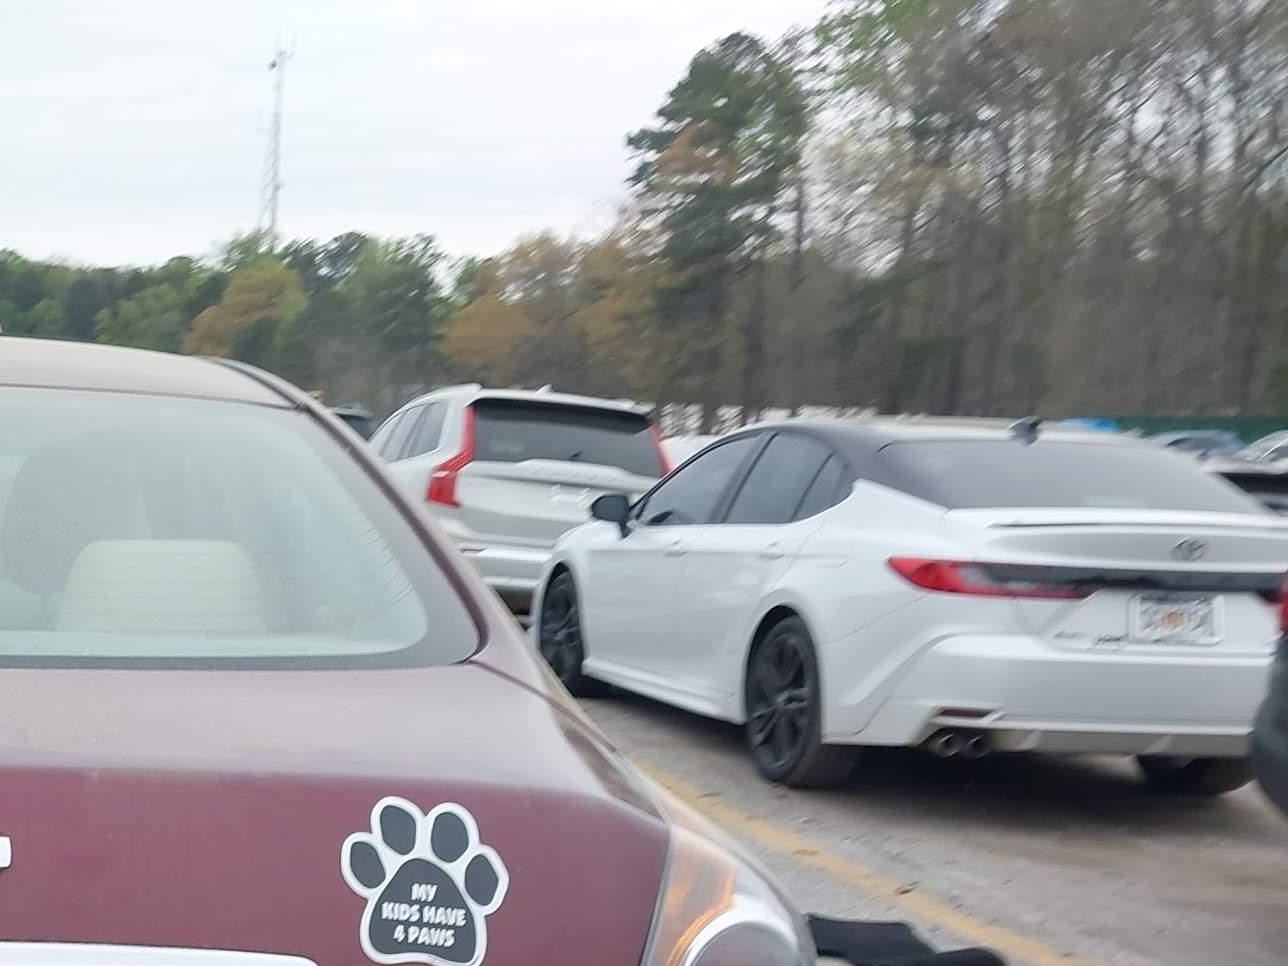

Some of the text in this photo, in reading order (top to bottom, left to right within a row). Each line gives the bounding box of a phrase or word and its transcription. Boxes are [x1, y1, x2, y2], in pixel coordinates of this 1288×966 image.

[410, 883, 439, 902] MY
[381, 901, 467, 927] KIDS HAVE
[392, 924, 455, 948] 4 PAWS
